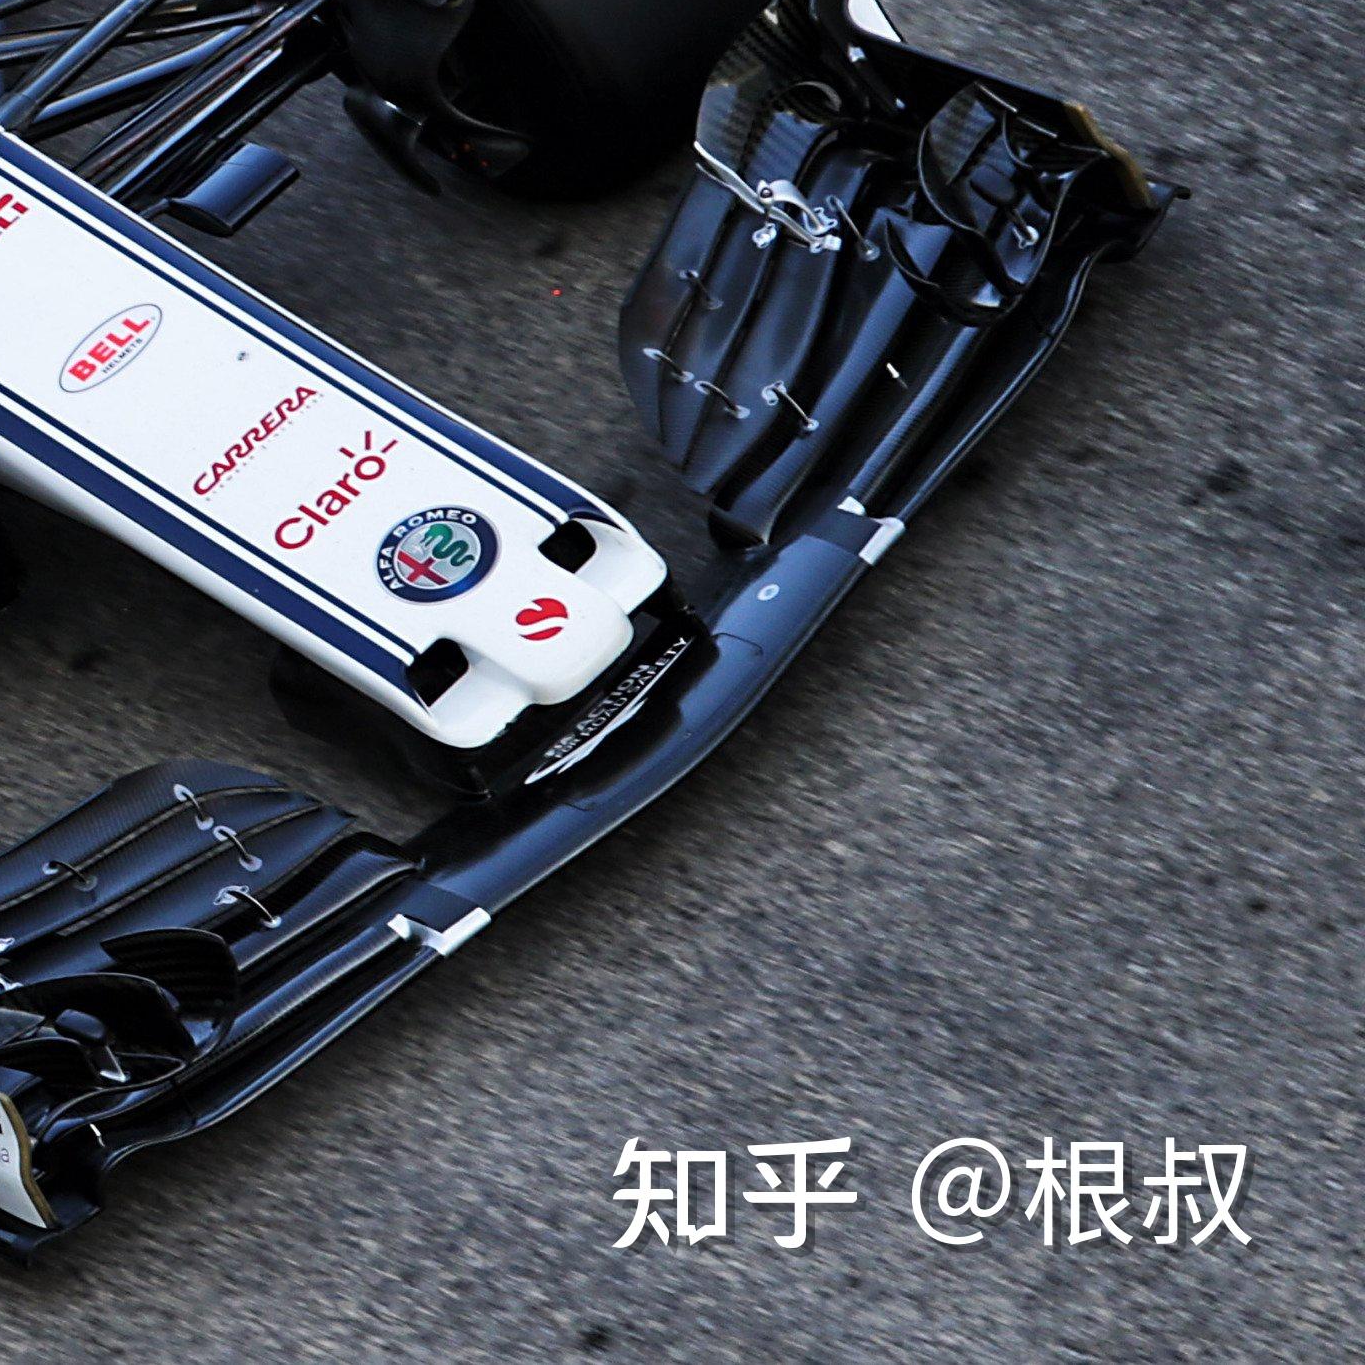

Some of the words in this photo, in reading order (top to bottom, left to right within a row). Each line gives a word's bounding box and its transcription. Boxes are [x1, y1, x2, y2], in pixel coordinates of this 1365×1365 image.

[67, 317, 151, 382] BELL
[102, 337, 144, 375] HELMETS
[193, 386, 317, 495] CARRERA
[274, 455, 386, 550] Claro
[379, 545, 405, 591] ALFA
[393, 509, 478, 539] ROMEO
[575, 664, 650, 731] ACTION
[580, 697, 628, 737] ROAD
[627, 637, 688, 695] SAFETY
